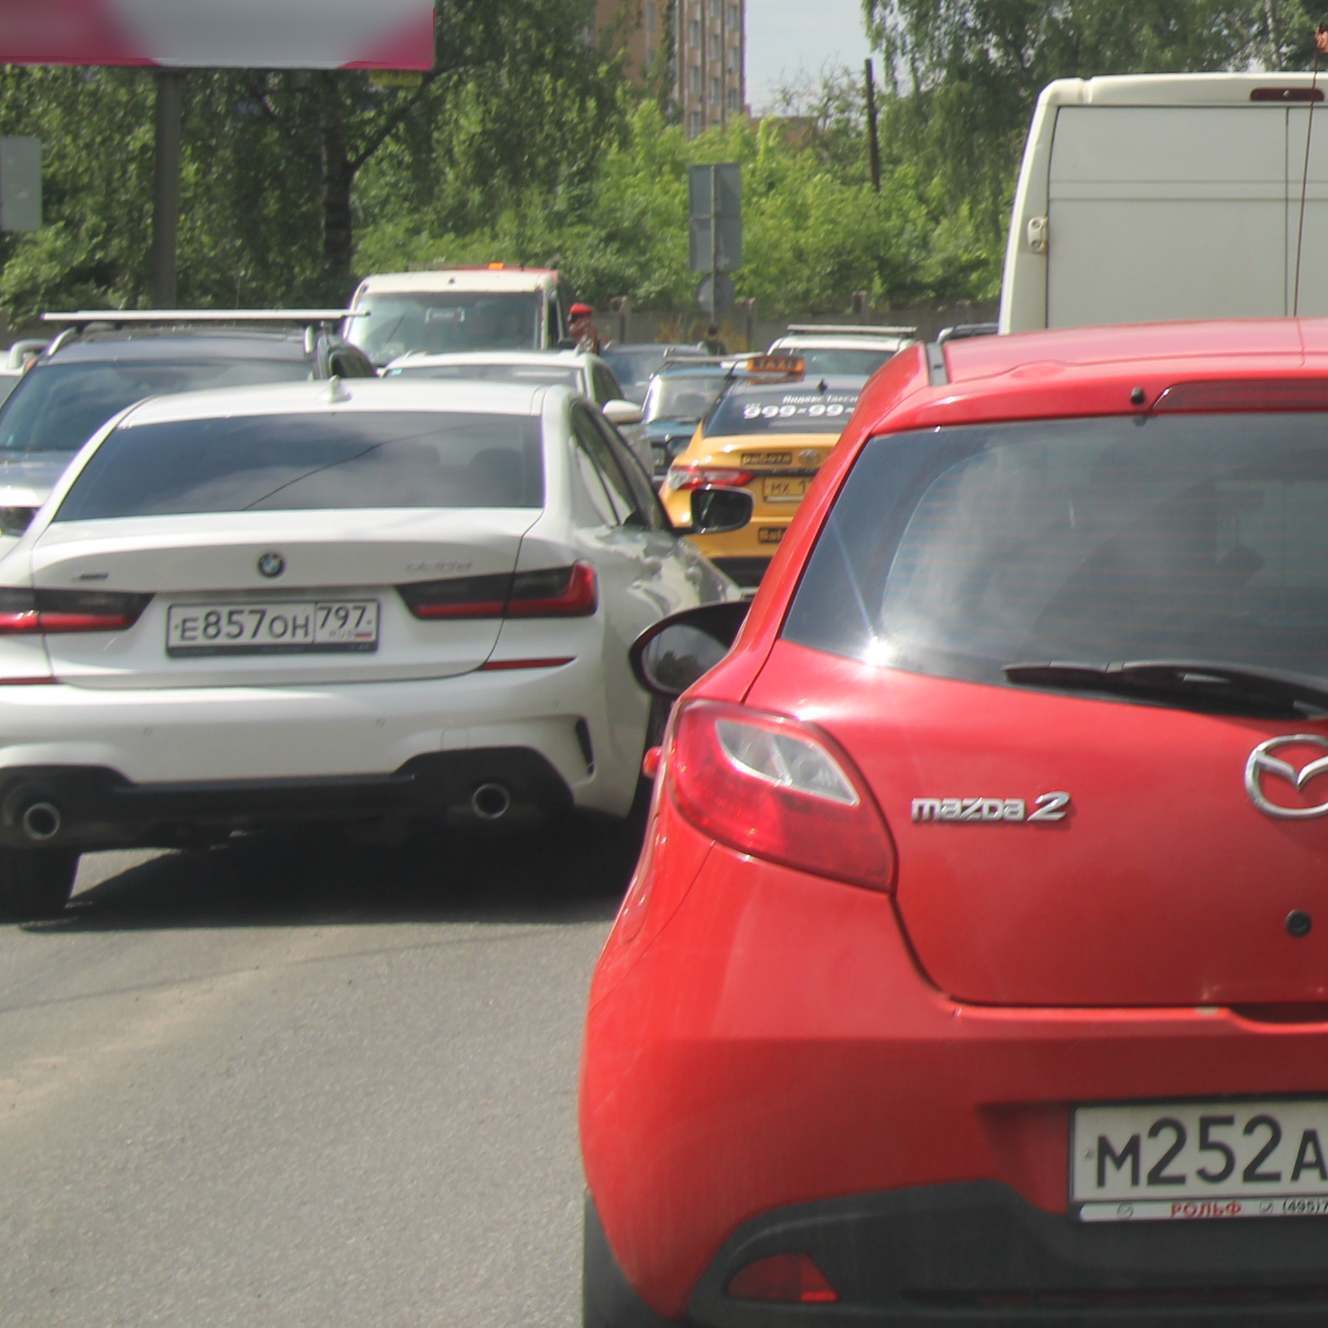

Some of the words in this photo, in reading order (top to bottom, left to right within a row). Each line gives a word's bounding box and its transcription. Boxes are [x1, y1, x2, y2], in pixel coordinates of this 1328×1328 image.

[179, 608, 310, 642] Е857ОН
[317, 604, 367, 630] 797
[911, 798, 1025, 823] mazda
[1027, 791, 1071, 822] 2
[1170, 1200, 1243, 1218] РОЛЬФ
